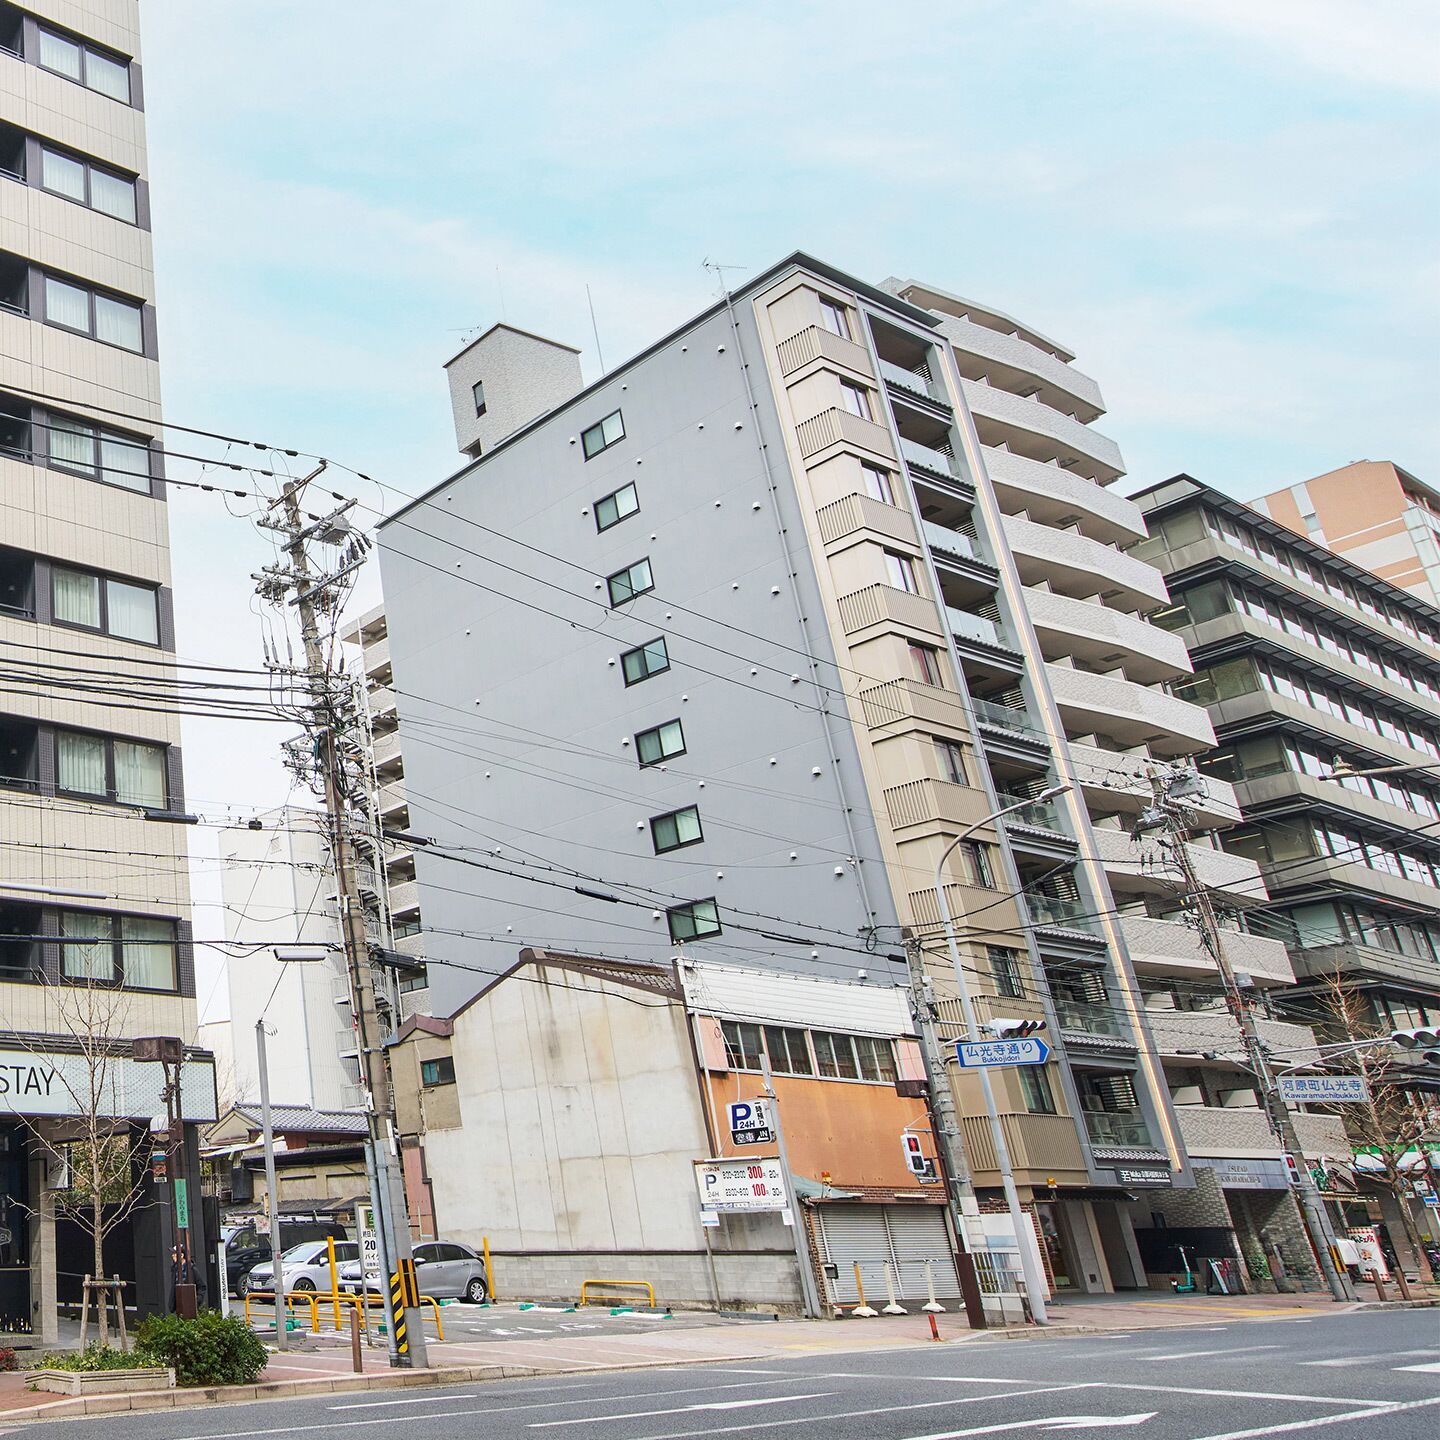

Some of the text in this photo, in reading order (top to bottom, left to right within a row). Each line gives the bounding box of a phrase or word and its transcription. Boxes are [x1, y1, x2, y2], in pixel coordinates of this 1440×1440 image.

[966, 1041, 1032, 1057] 仏光寺通り
[982, 1055, 1020, 1063] Bukkojidori
[1282, 1079, 1361, 1091] 河原町仏光寺
[1284, 1092, 1364, 1100] Kawaramachibukkoji
[731, 1103, 751, 1130] P
[740, 1120, 755, 1129] 24H
[759, 1130, 768, 1138] IN
[705, 1174, 717, 1191] P
